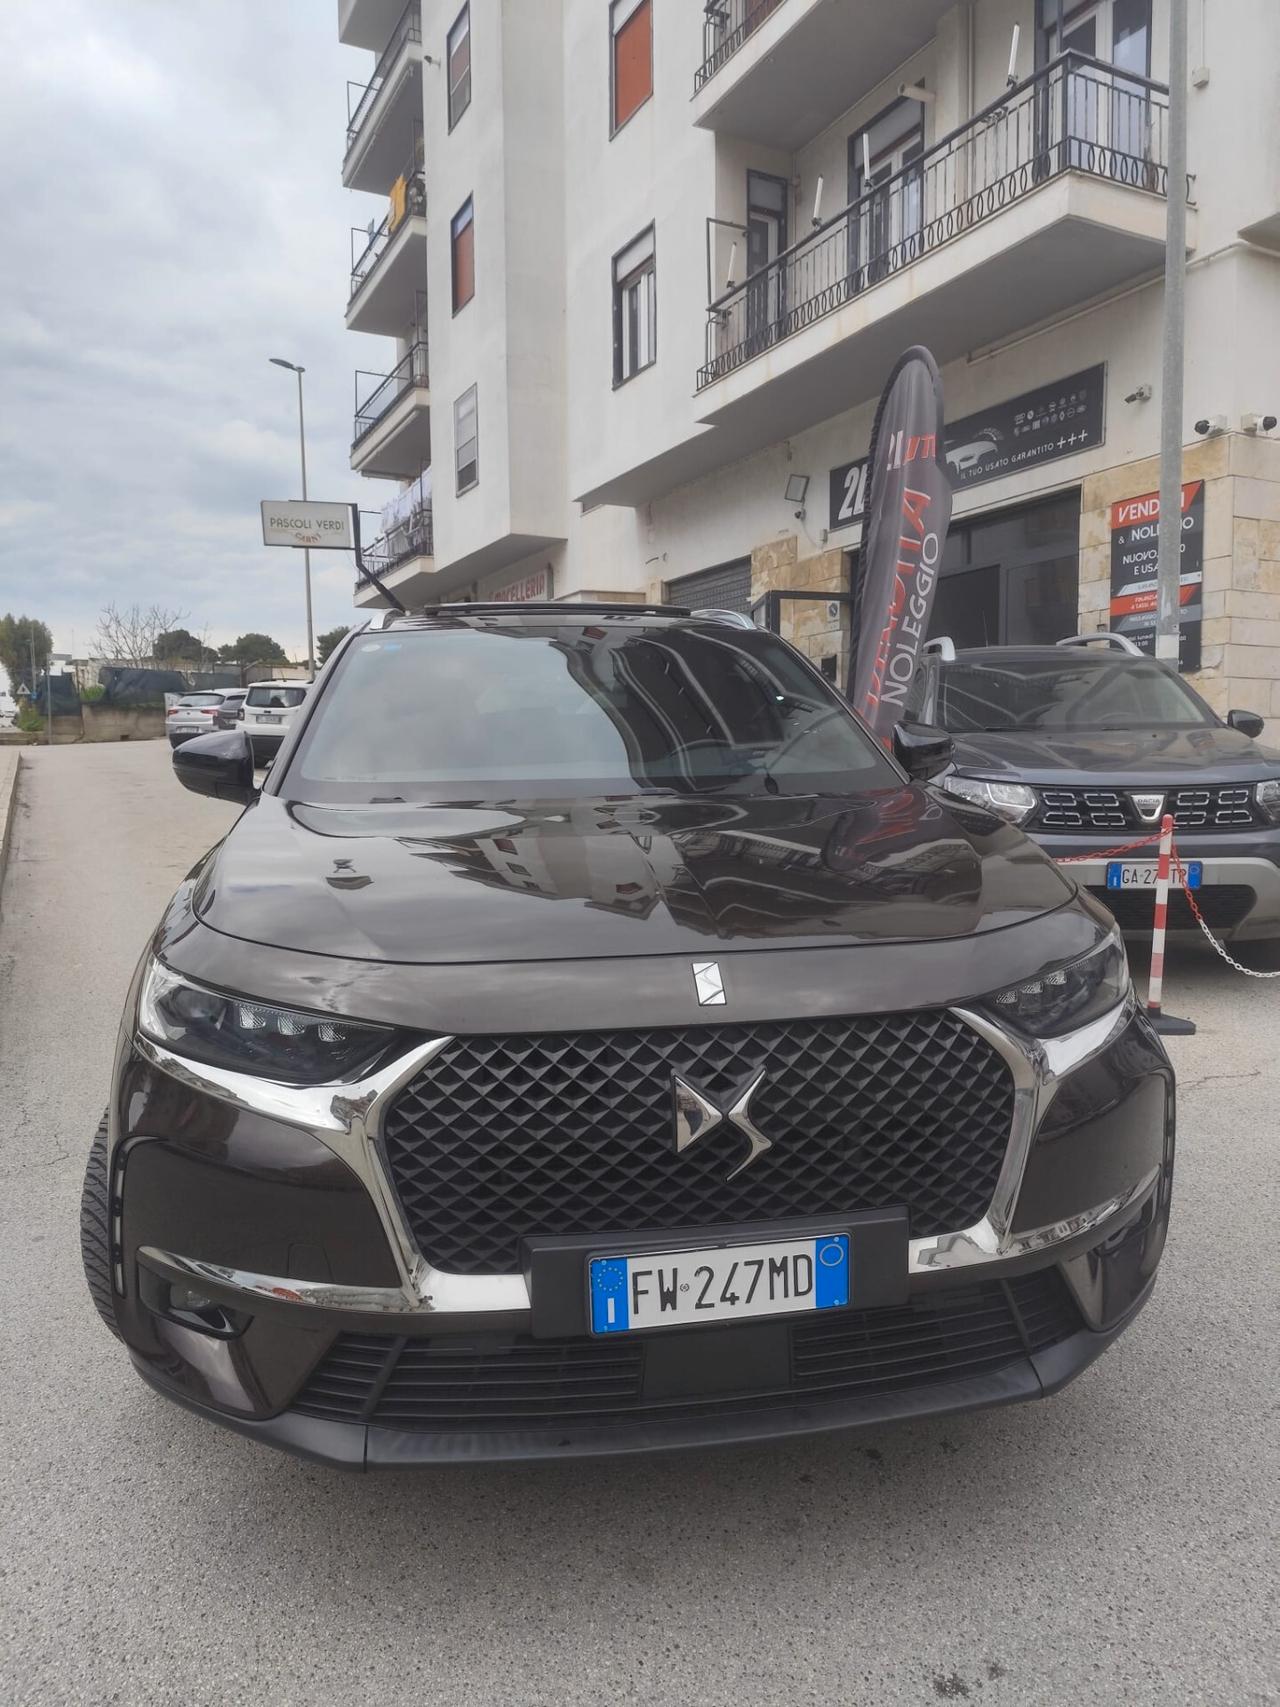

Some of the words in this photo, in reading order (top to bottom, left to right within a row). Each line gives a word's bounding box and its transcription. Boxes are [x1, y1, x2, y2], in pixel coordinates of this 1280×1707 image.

[969, 466, 983, 477] TUO
[985, 457, 1009, 472] USATO
[1011, 442, 1055, 463] GARANTITO
[269, 517, 312, 529] PASCOLI
[316, 520, 345, 531] VERDI
[880, 532, 939, 706] NOLEGGIO
